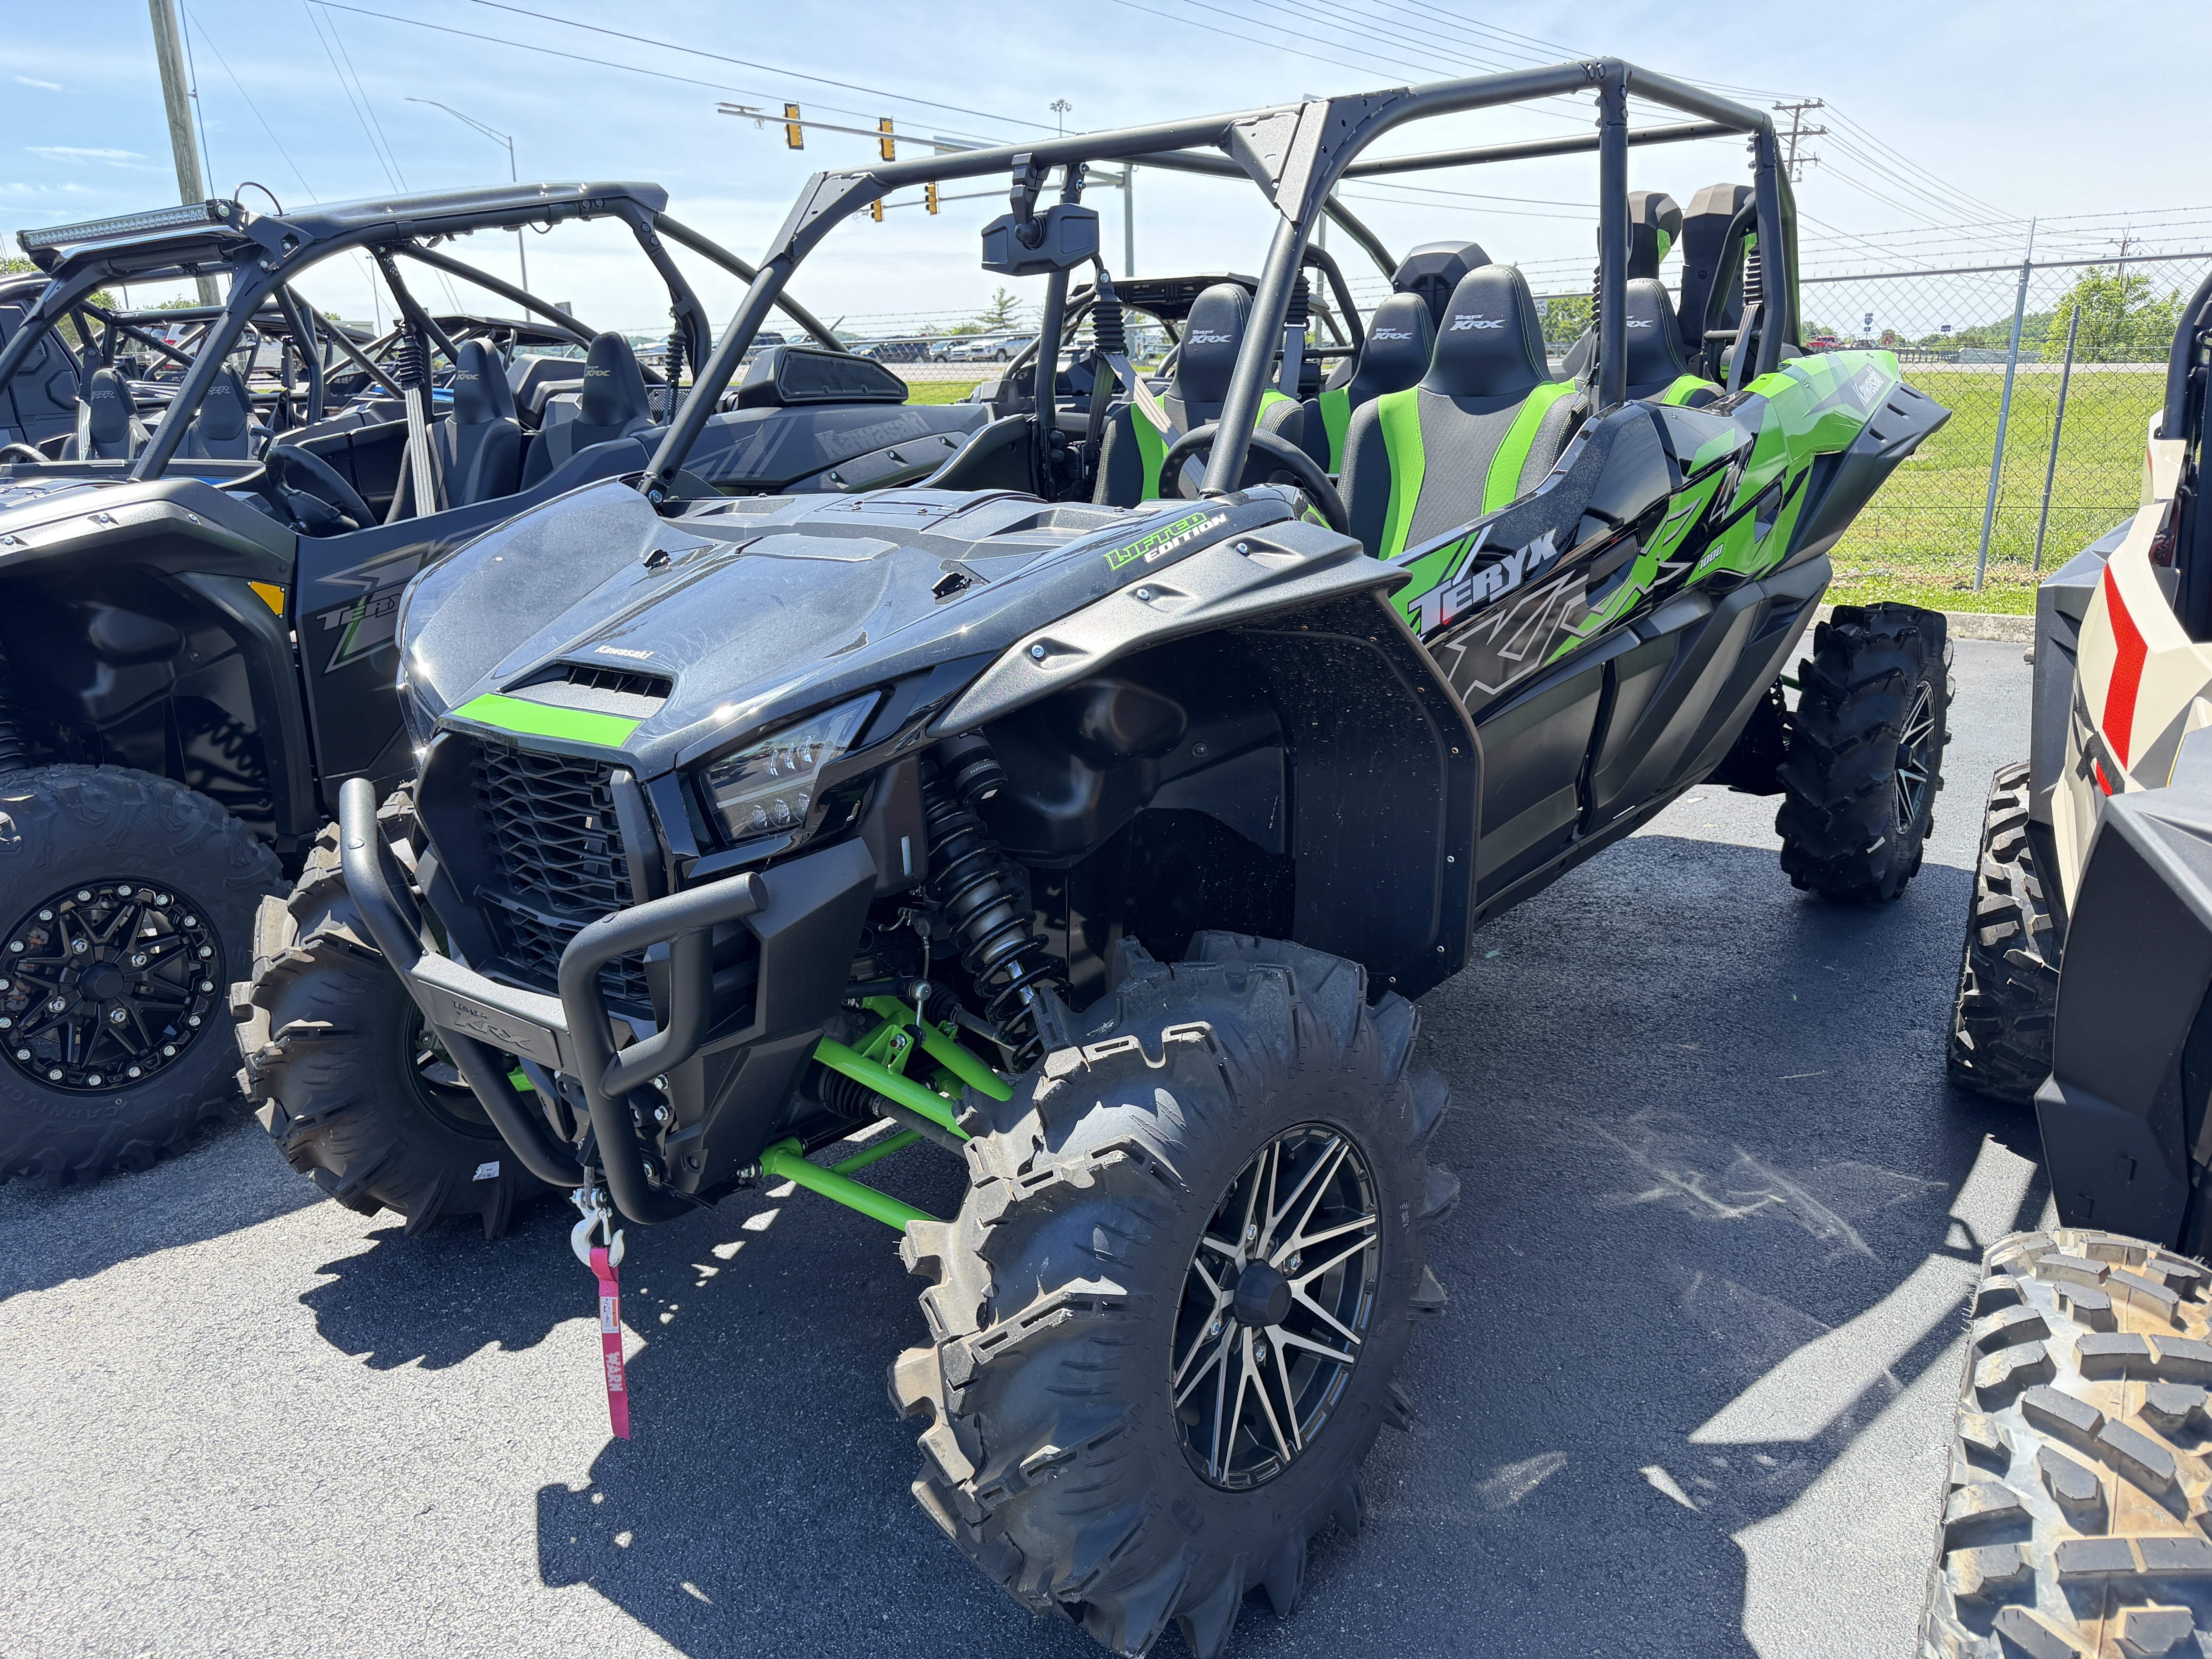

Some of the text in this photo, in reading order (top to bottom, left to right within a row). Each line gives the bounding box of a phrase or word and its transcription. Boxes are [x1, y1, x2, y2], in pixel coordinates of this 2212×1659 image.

[1188, 335, 1232, 344] KRX
[1449, 320, 1506, 331] KRX
[92, 391, 114, 400] RZR
[1851, 365, 1884, 407] Kawasaki
[815, 411, 933, 460] Kawasaki
[1104, 512, 1207, 571] LIFTED
[1144, 513, 1228, 563] EDITION
[1699, 543, 1724, 571] 1000
[1408, 528, 1558, 635] TERYX
[594, 645, 654, 659] Kawasaki
[455, 1011, 536, 1054] KRX
[0, 1077, 118, 1119] CARNIVOR
[605, 1351, 624, 1392] WARN
